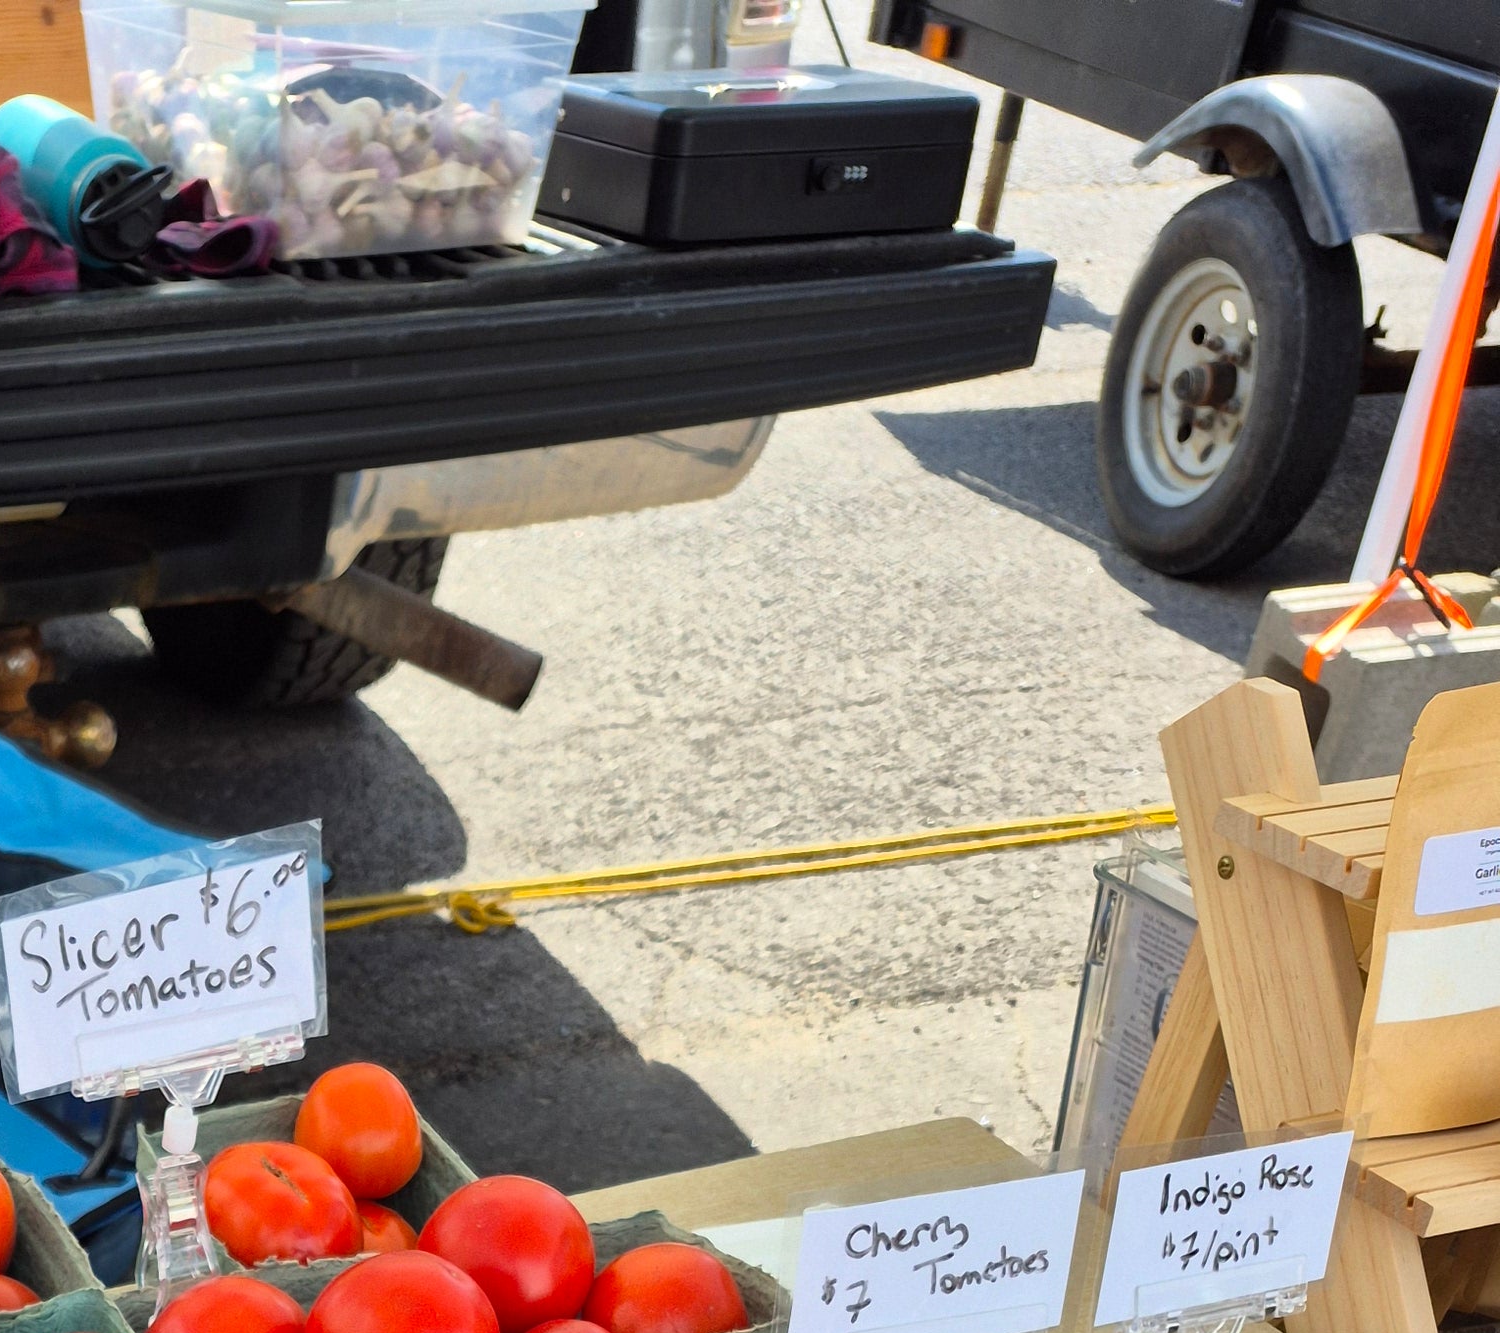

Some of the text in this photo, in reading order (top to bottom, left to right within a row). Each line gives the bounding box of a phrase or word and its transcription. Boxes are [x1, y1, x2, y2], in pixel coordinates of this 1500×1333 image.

[20, 914, 179, 993] Slicer
[56, 945, 277, 1021] Tomatoes
[1159, 1153, 1315, 1215] Indigo Rose
[845, 1215, 969, 1259] Cherry
[913, 1245, 1049, 1295] Tomatoes
